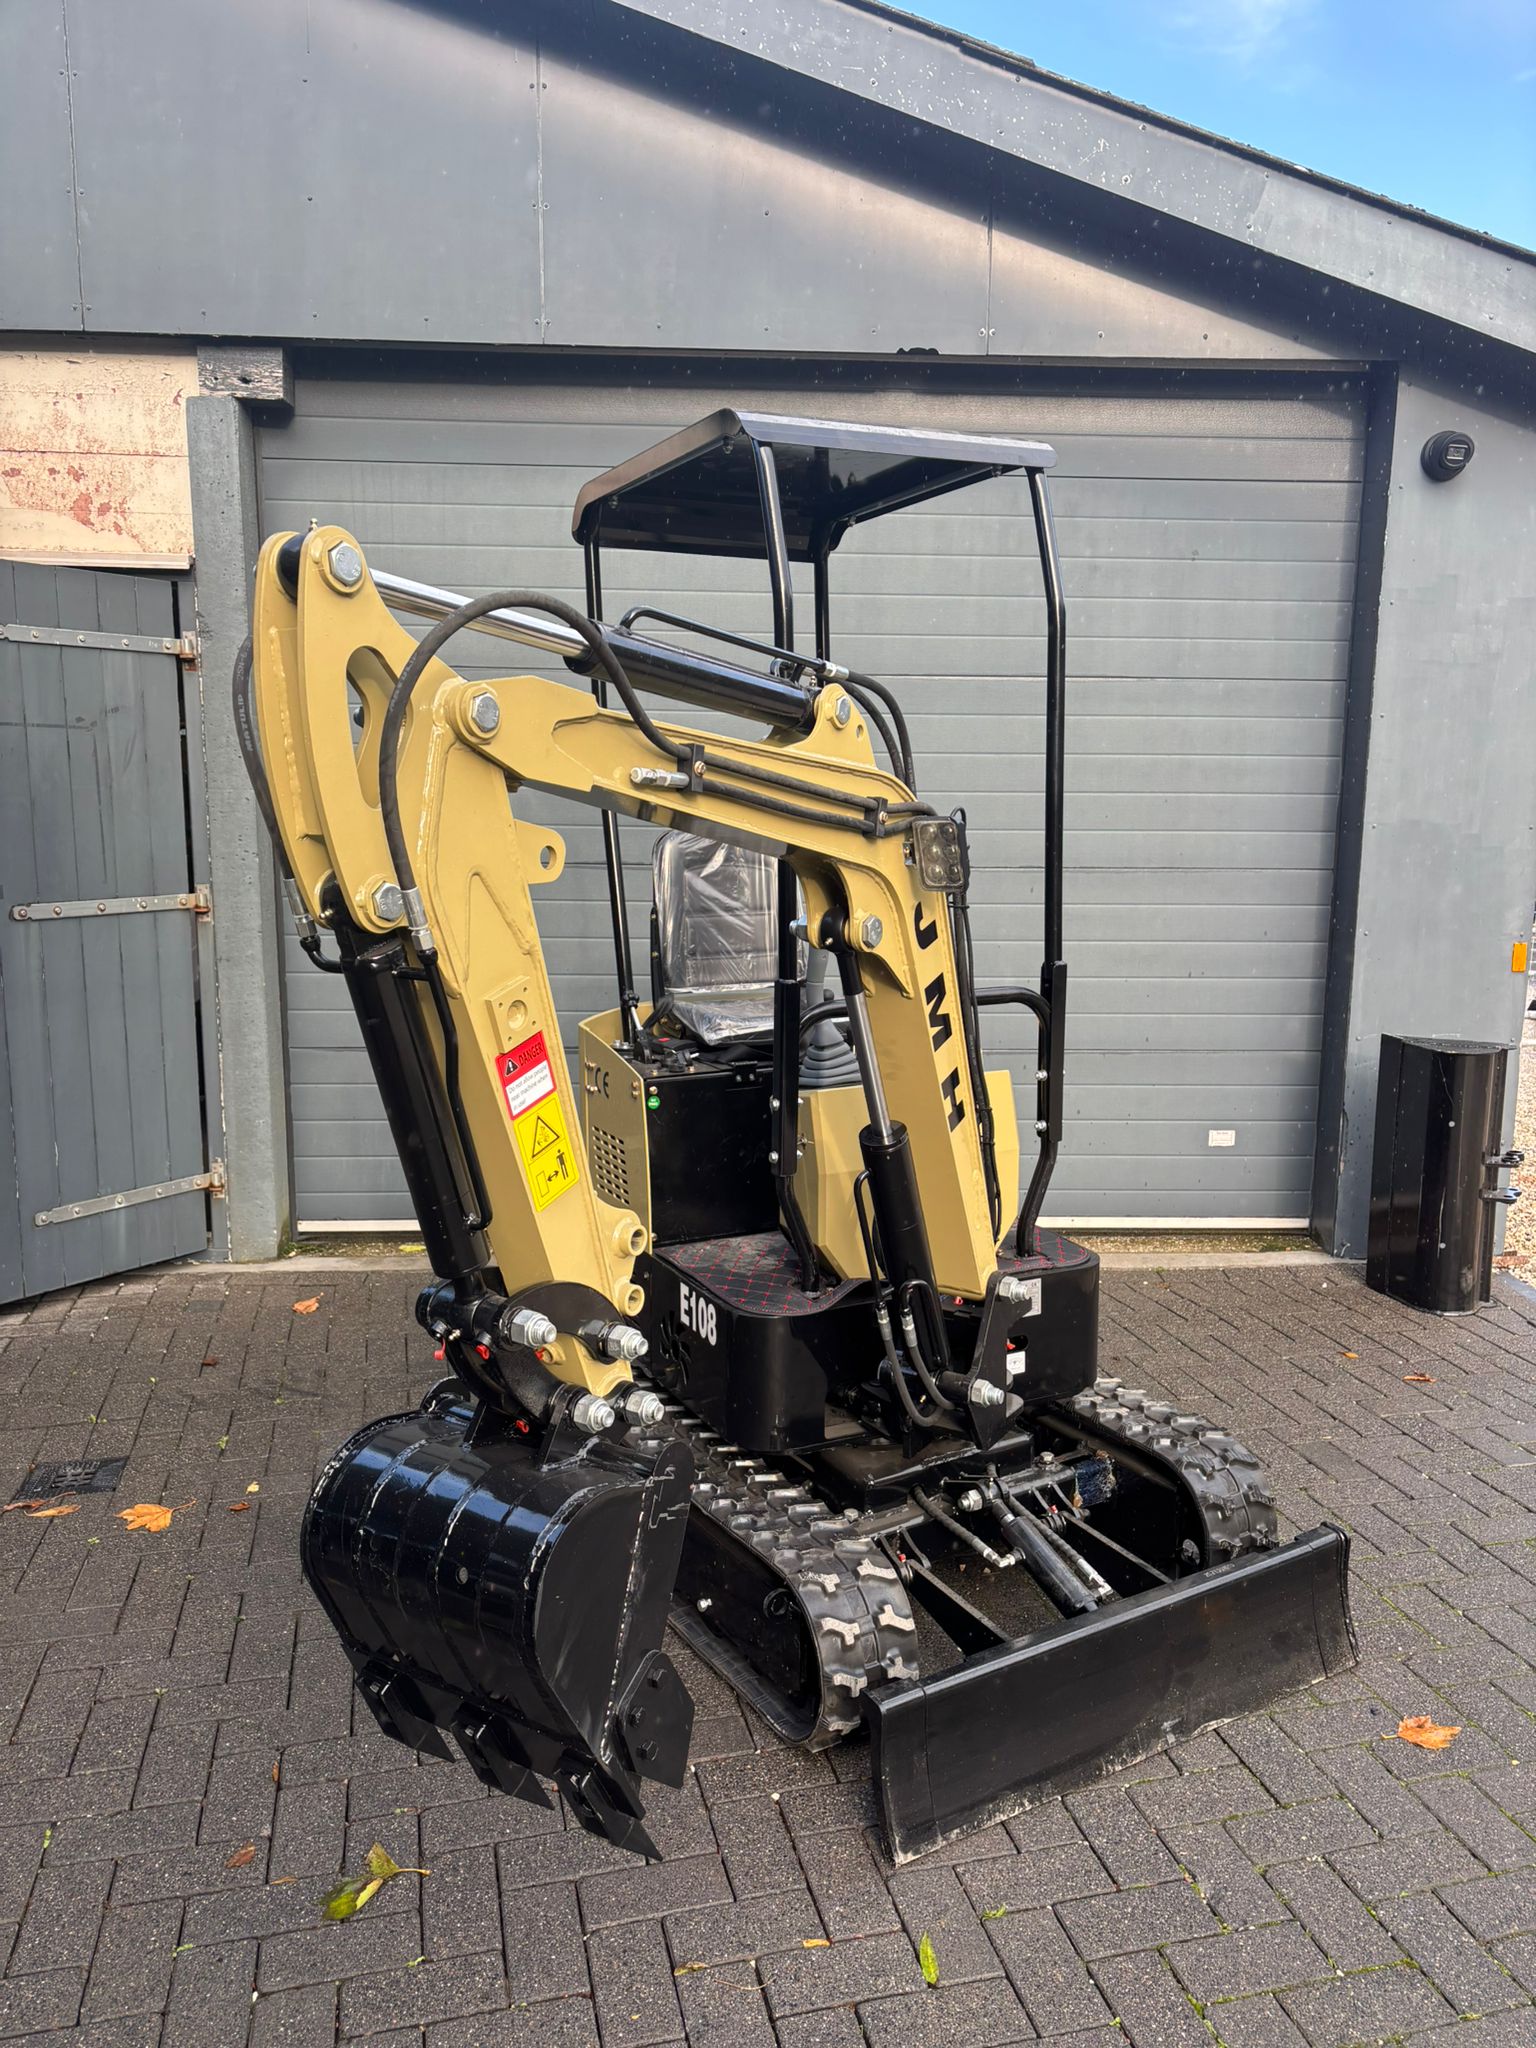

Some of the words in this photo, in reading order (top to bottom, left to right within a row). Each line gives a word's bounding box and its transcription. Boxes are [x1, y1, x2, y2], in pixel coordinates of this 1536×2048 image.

[914, 901, 965, 1132] JMH
[518, 1042, 544, 1067] DANGER
[595, 1067, 609, 1099] CE
[680, 1282, 717, 1347] E108
